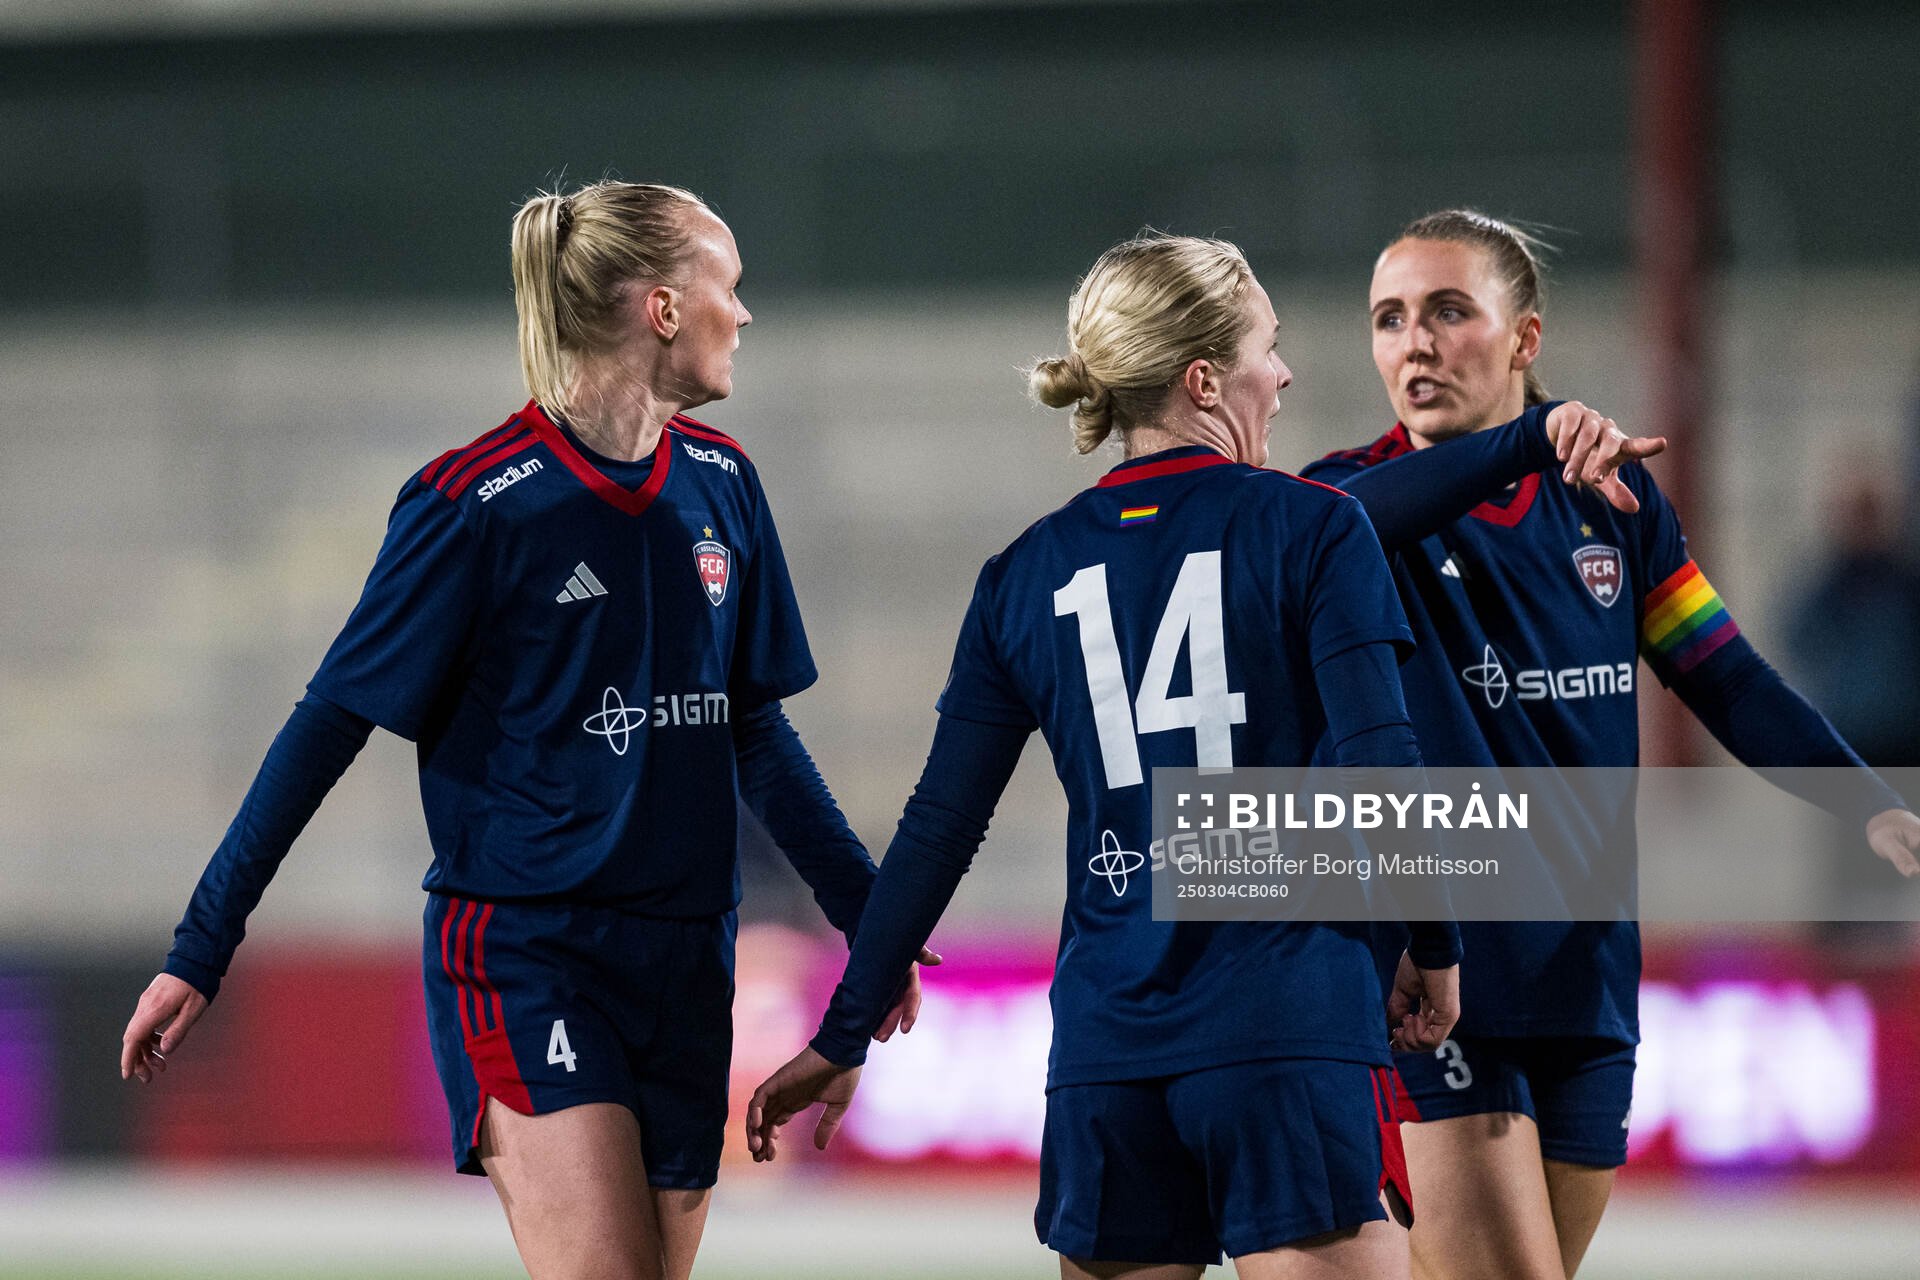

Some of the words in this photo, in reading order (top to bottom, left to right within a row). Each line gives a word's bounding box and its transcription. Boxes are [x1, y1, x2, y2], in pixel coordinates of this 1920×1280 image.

[477, 458, 544, 502] stadium
[682, 442, 738, 476] stadium
[700, 558, 724, 575] FCR
[1582, 560, 1615, 578] FCR
[1053, 550, 1247, 790] 14
[546, 1019, 577, 1073] 4
[1435, 1039, 1473, 1090] 3
